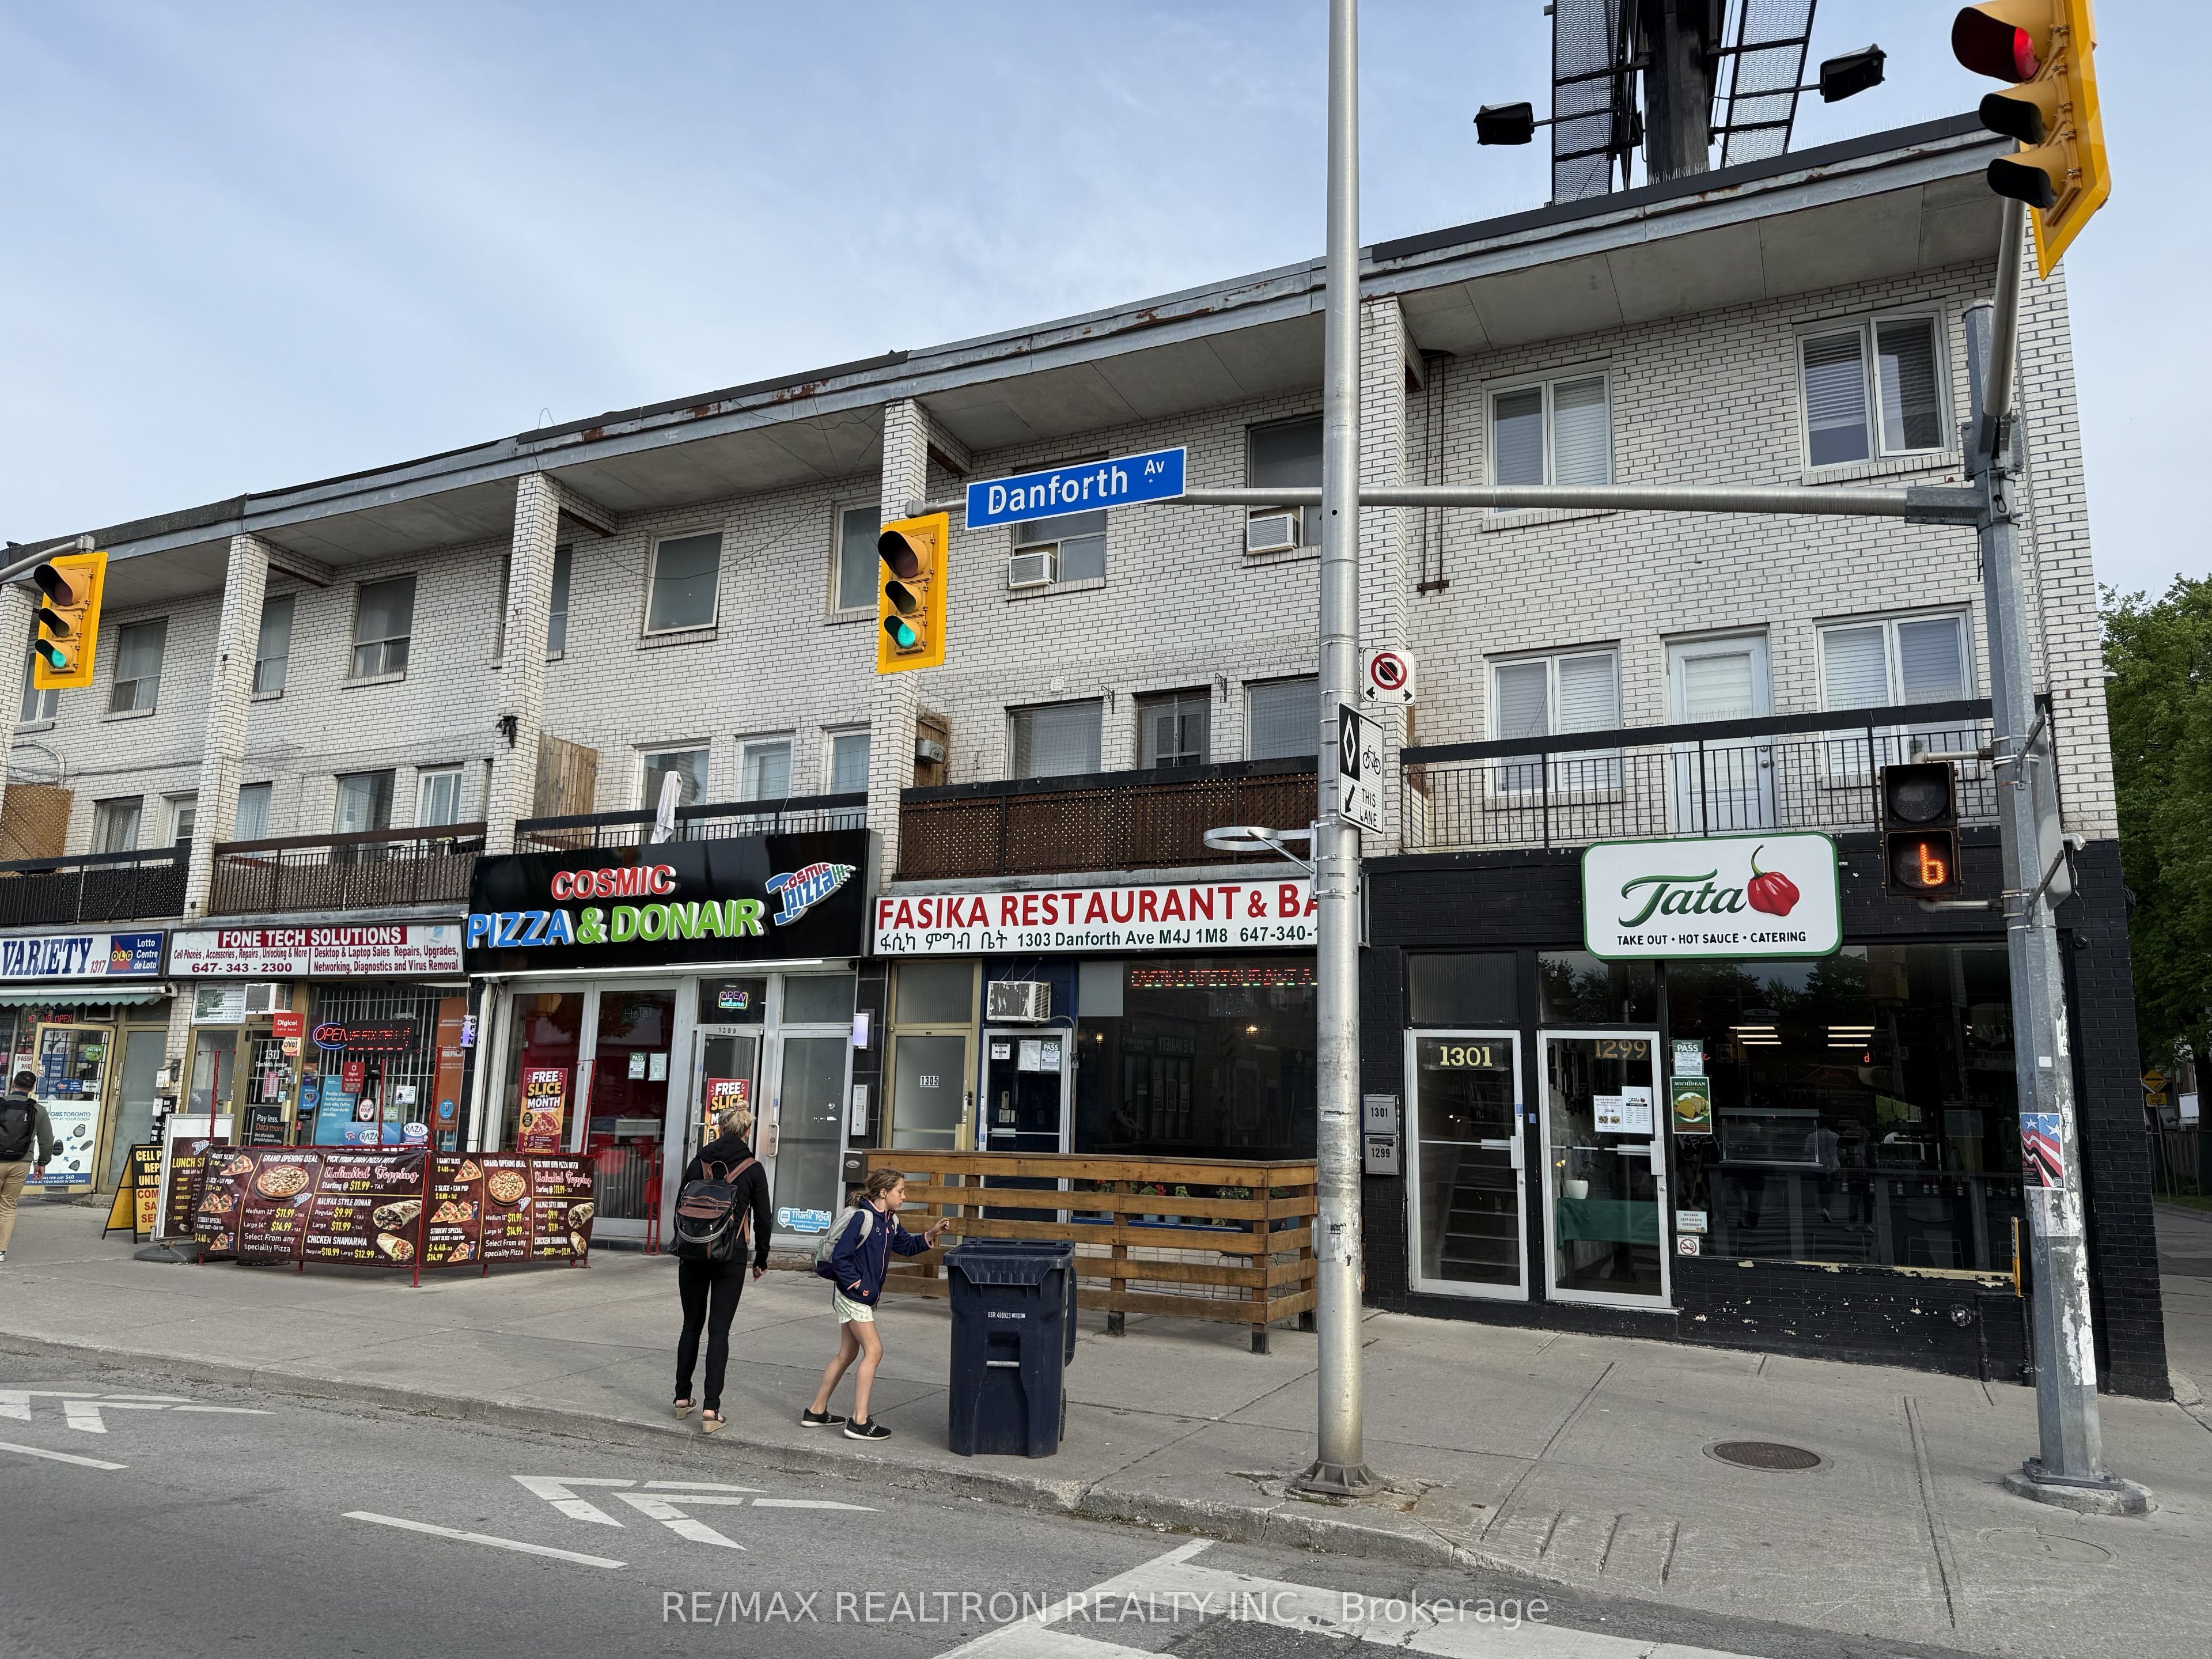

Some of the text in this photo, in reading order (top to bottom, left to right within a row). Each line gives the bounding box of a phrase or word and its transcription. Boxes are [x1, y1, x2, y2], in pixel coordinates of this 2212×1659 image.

[988, 460, 1165, 515] Danforth Av
[1362, 789, 1376, 807] THIS
[1360, 806, 1377, 827] LANE
[551, 864, 673, 900] COSMIC
[1618, 868, 1747, 927] Tata
[878, 896, 990, 930] FASIKA
[1001, 886, 1241, 926] RESTAURANT
[1247, 890, 1267, 918] &
[467, 899, 762, 949] PIZZA & DONAIR
[222, 926, 402, 947] FONE TECH SOLUTIONS
[1018, 932, 1051, 948] 1303
[1055, 931, 1120, 946] Danforth
[1125, 930, 1154, 945] Ave
[1159, 929, 1190, 944] M4J
[1196, 928, 1228, 943] 1M8
[1618, 931, 1806, 945] TAKE OUT HOT SAUCE CATERING
[137, 938, 155, 948] Lotto
[2, 938, 106, 976] VARIETY 1317
[112, 952, 132, 960] OLG
[137, 949, 158, 958] Centre
[174, 949, 307, 960] Cell Phones Accessories Repairs Unlocking & More
[315, 945, 459, 960] Desktop & Laptop Sales Repairs, Upgrades,
[142, 961, 157, 970] Loto
[226, 963, 249, 972] 343
[261, 963, 292, 972] 2300
[314, 959, 458, 974] Networking, Diagnostics and Virus Removal
[721, 991, 746, 1002] OPEN
[721, 999, 744, 1007] welcome
[55, 1014, 73, 1023] OPEN
[624, 1007, 651, 1019] Halal
[316, 1028, 348, 1041] OPEN
[265, 1049, 280, 1059] 1311
[1595, 1040, 1647, 1059] 1299
[1440, 1046, 1493, 1067] 1301
[532, 1071, 559, 1084] FREE
[922, 1076, 938, 1085] 1305
[528, 1082, 562, 1097] SLICE
[715, 1082, 741, 1096] FREE
[527, 1097, 560, 1109] MONTH
[1371, 1107, 1388, 1118] 1301
[257, 1115, 267, 1123] Pay
[136, 1151, 155, 1161] CELL
[1371, 1148, 1391, 1158] 1299
[172, 1157, 195, 1168] LUNCH
[324, 1166, 370, 1179] Unlimited
[375, 1164, 419, 1183] Topping
[321, 1180, 370, 1191] Starting $11.99
[275, 1207, 295, 1218] $11.99
[334, 1207, 353, 1218] $9.99
[791, 1210, 812, 1219] Thank
[271, 1221, 291, 1232] $14.99
[331, 1221, 351, 1231] $11.99
[307, 1235, 368, 1246] CHICKEN SHAWARMA
[244, 1244, 272, 1252] speciality
[321, 1248, 339, 1256] $10.99
[354, 1249, 374, 1259] $12.99
